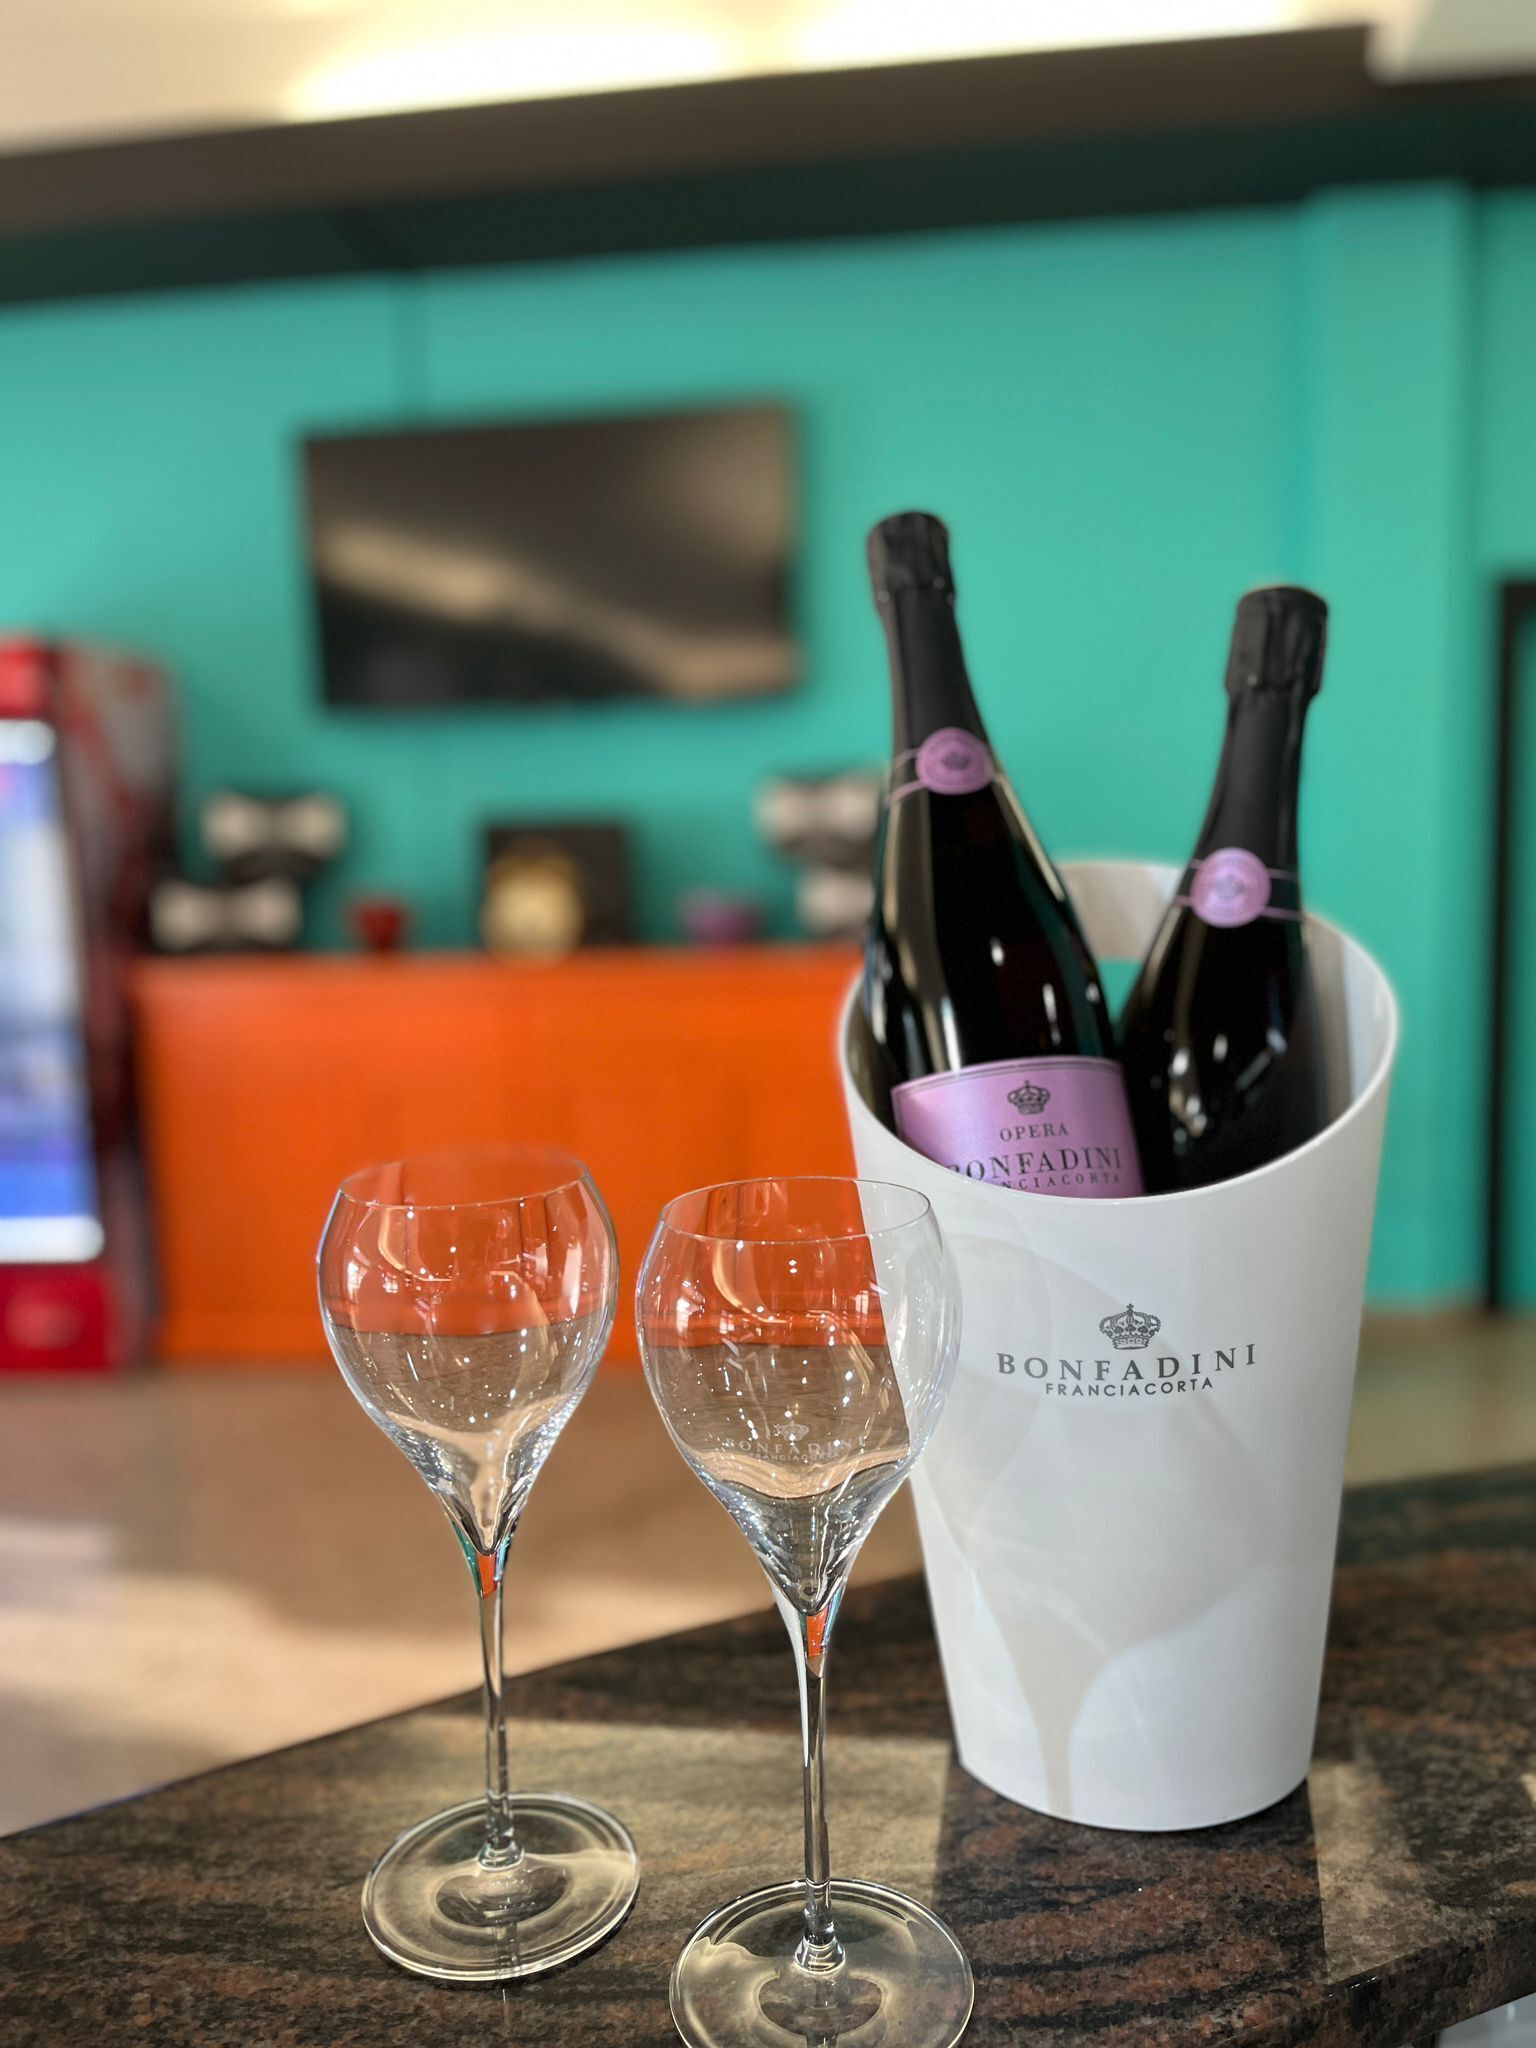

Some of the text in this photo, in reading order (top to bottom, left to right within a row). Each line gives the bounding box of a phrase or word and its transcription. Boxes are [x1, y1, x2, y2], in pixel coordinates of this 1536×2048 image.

[1000, 1123, 1069, 1142] OPERA
[1001, 1174, 1121, 1189] NCIACORTA
[996, 1343, 1255, 1381] BONFADINI
[1046, 1377, 1213, 1397] FRANCIACORTA
